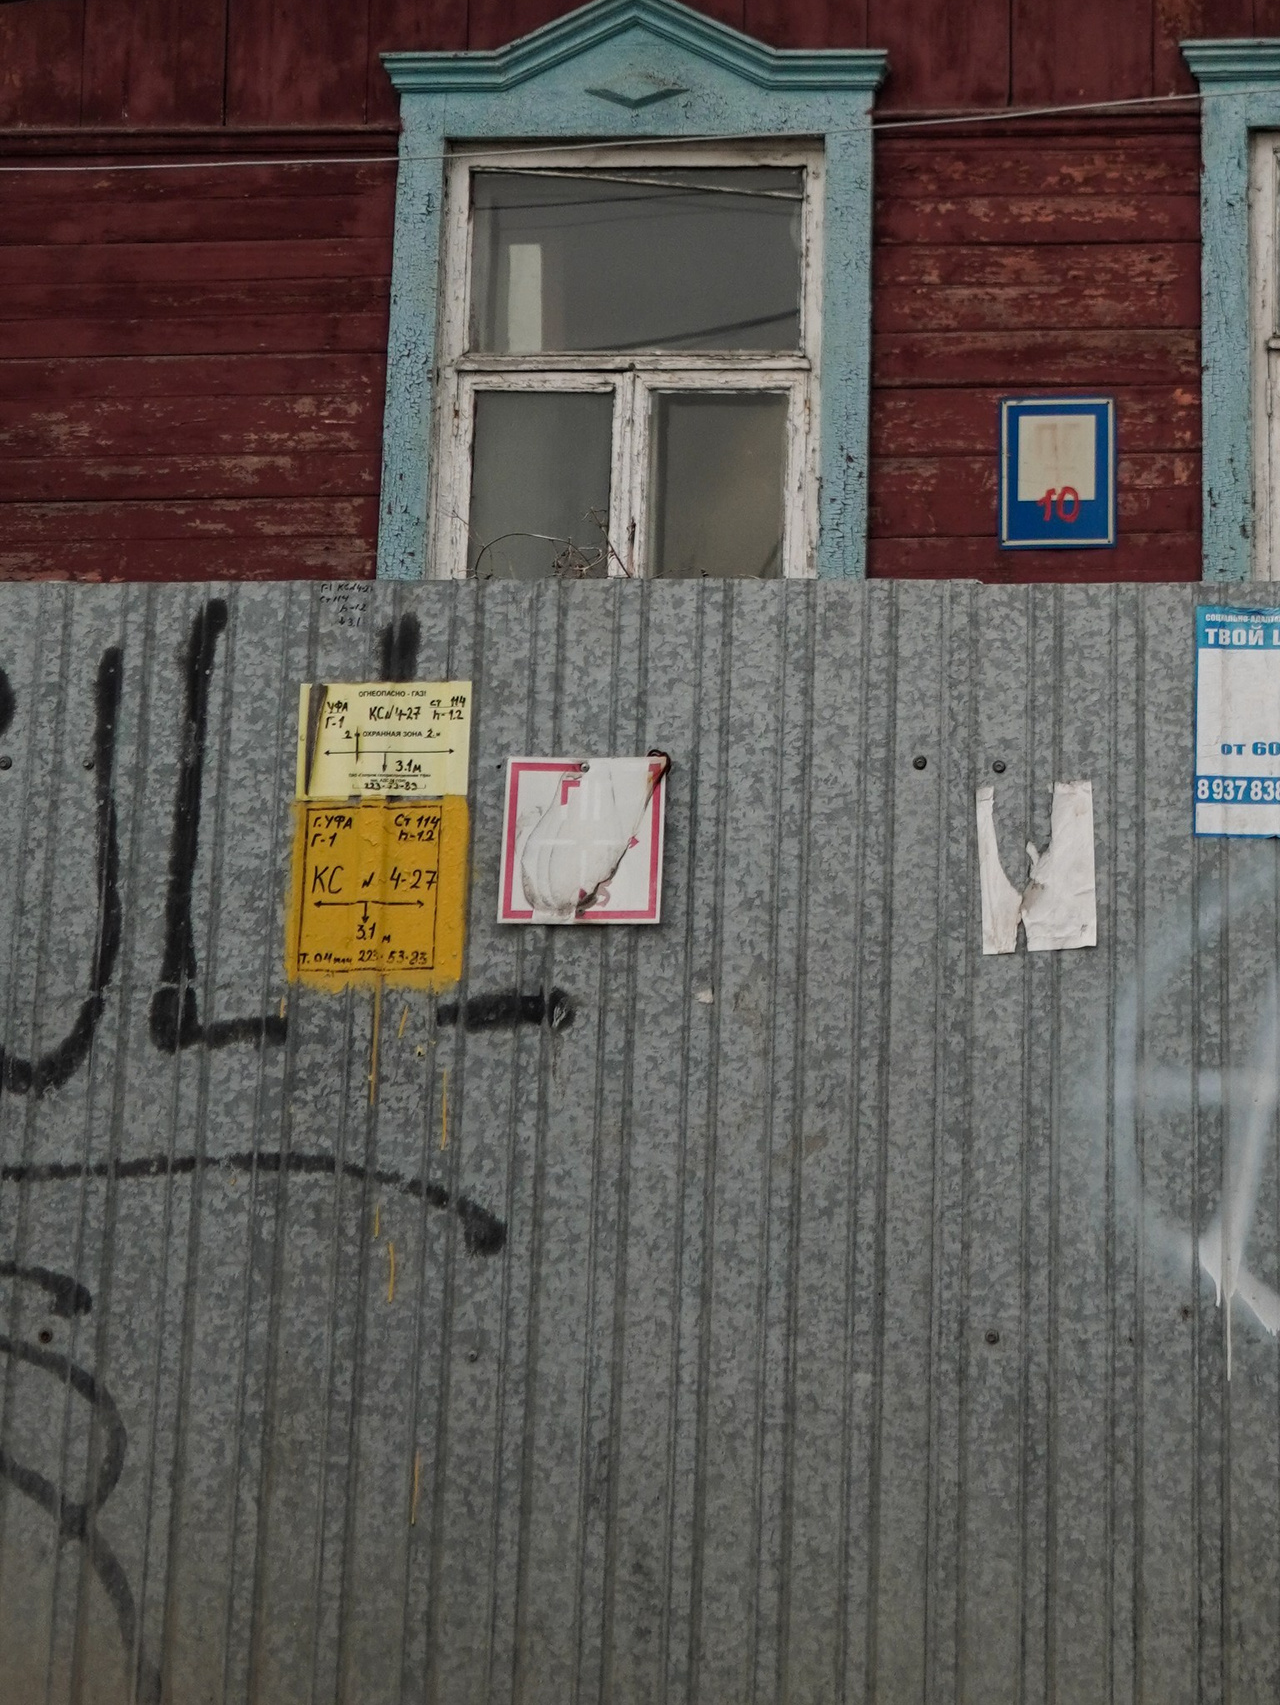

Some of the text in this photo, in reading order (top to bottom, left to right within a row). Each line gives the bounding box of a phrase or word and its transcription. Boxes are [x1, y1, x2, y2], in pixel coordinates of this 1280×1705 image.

[1037, 486, 1081, 523] 10
[1204, 625, 1264, 646] ТВОЙ
[327, 701, 348, 714] УФА
[450, 696, 467, 708] 114
[325, 716, 345, 729] Г-1
[362, 730, 401, 738] ОХРАННАЯ
[403, 730, 423, 738] ЗОНА
[1197, 779, 1210, 799] 8
[1213, 779, 1247, 801] 937
[416, 815, 441, 829] 114
[311, 865, 344, 894] КС
[389, 866, 437, 891] 4-27
[355, 922, 376, 941] 3.1
